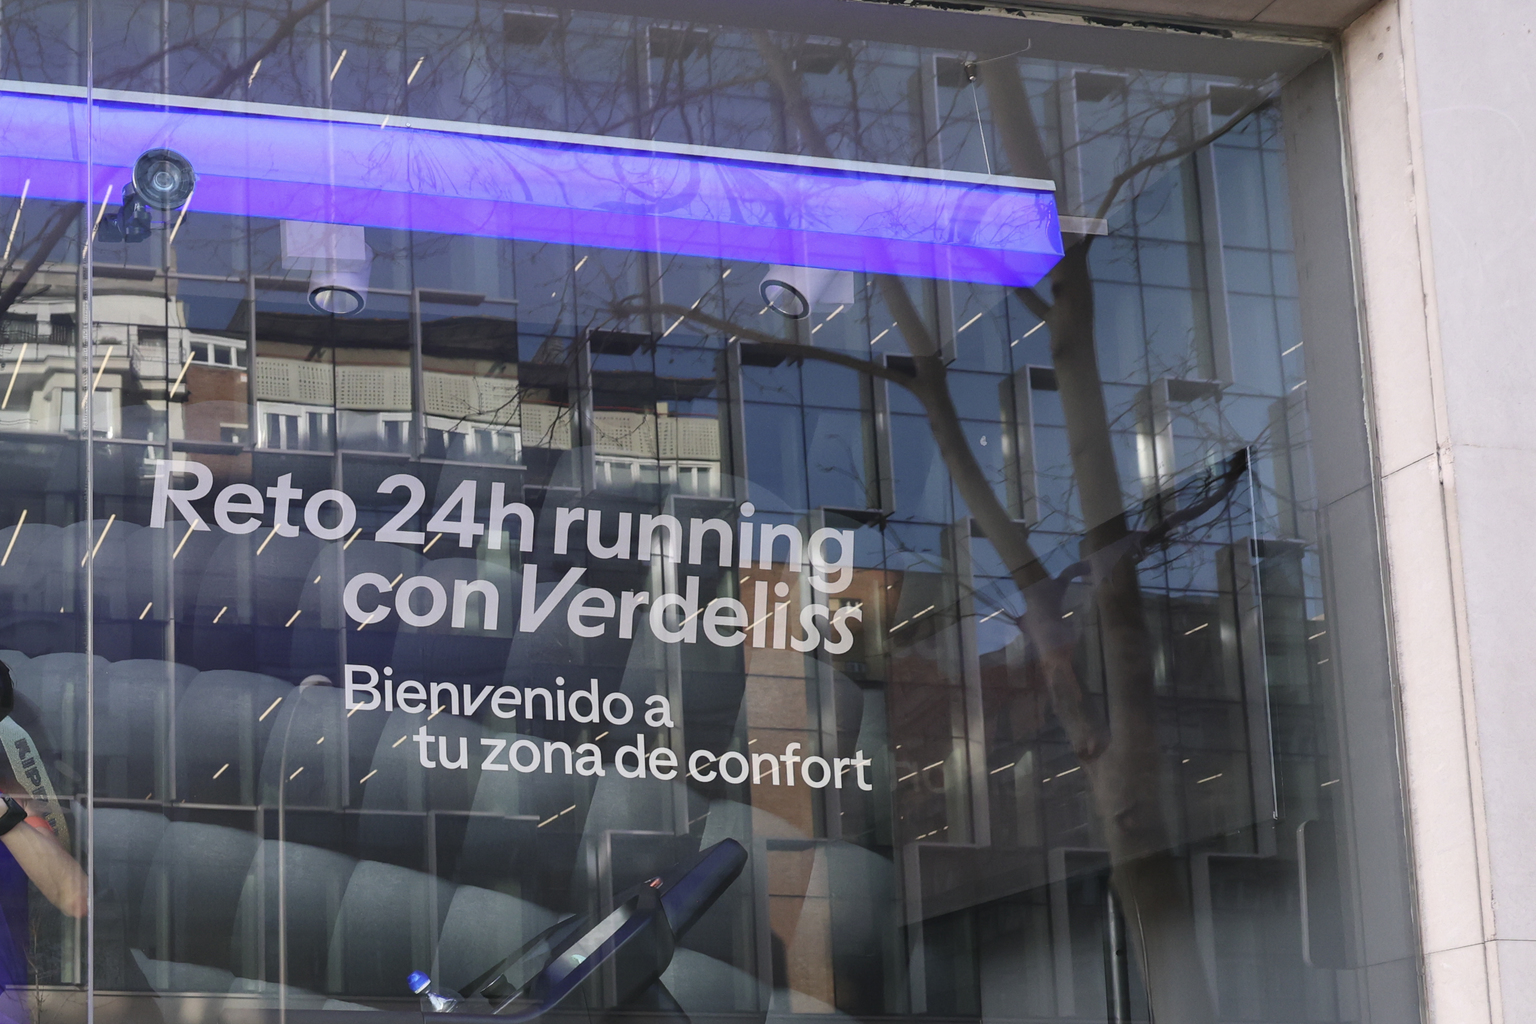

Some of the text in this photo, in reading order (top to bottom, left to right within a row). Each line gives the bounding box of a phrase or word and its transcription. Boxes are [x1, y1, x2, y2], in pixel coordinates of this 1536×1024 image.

[150, 459, 855, 594] Reto 24h running
[343, 564, 863, 654] con Verdeliss
[344, 664, 674, 728] Bienvenido a
[413, 725, 873, 791] tu zona de confort
